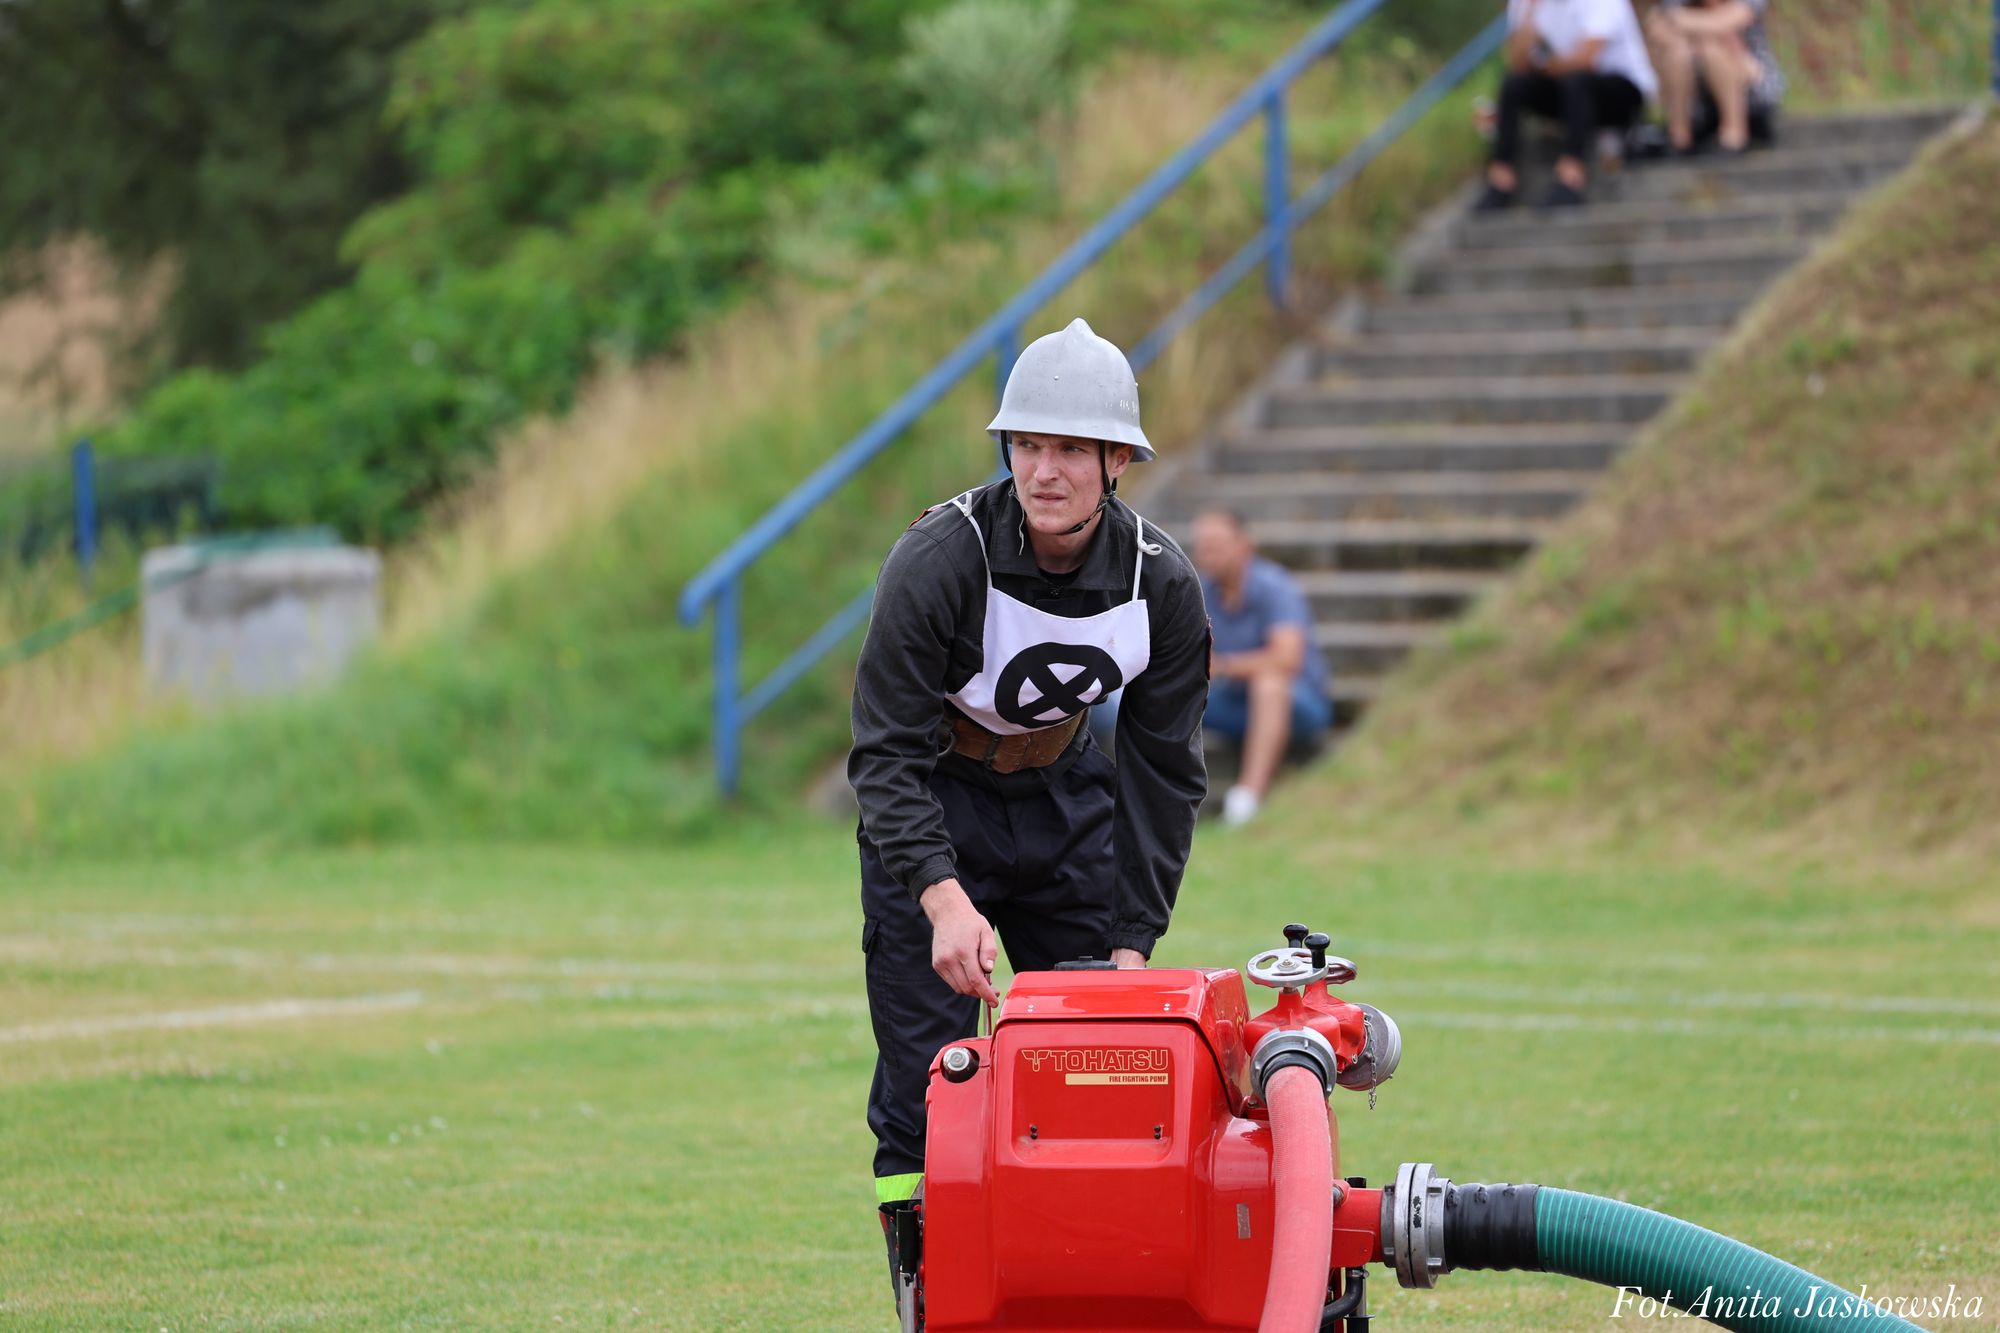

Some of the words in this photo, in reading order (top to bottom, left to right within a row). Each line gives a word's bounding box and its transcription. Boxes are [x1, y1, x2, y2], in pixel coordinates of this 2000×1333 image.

[1050, 1050, 1169, 1072] TOHATSU
[1109, 1075, 1121, 1083] FIRE
[1122, 1075, 1149, 1083] FIGHTING
[1150, 1075, 1167, 1083] PUMP
